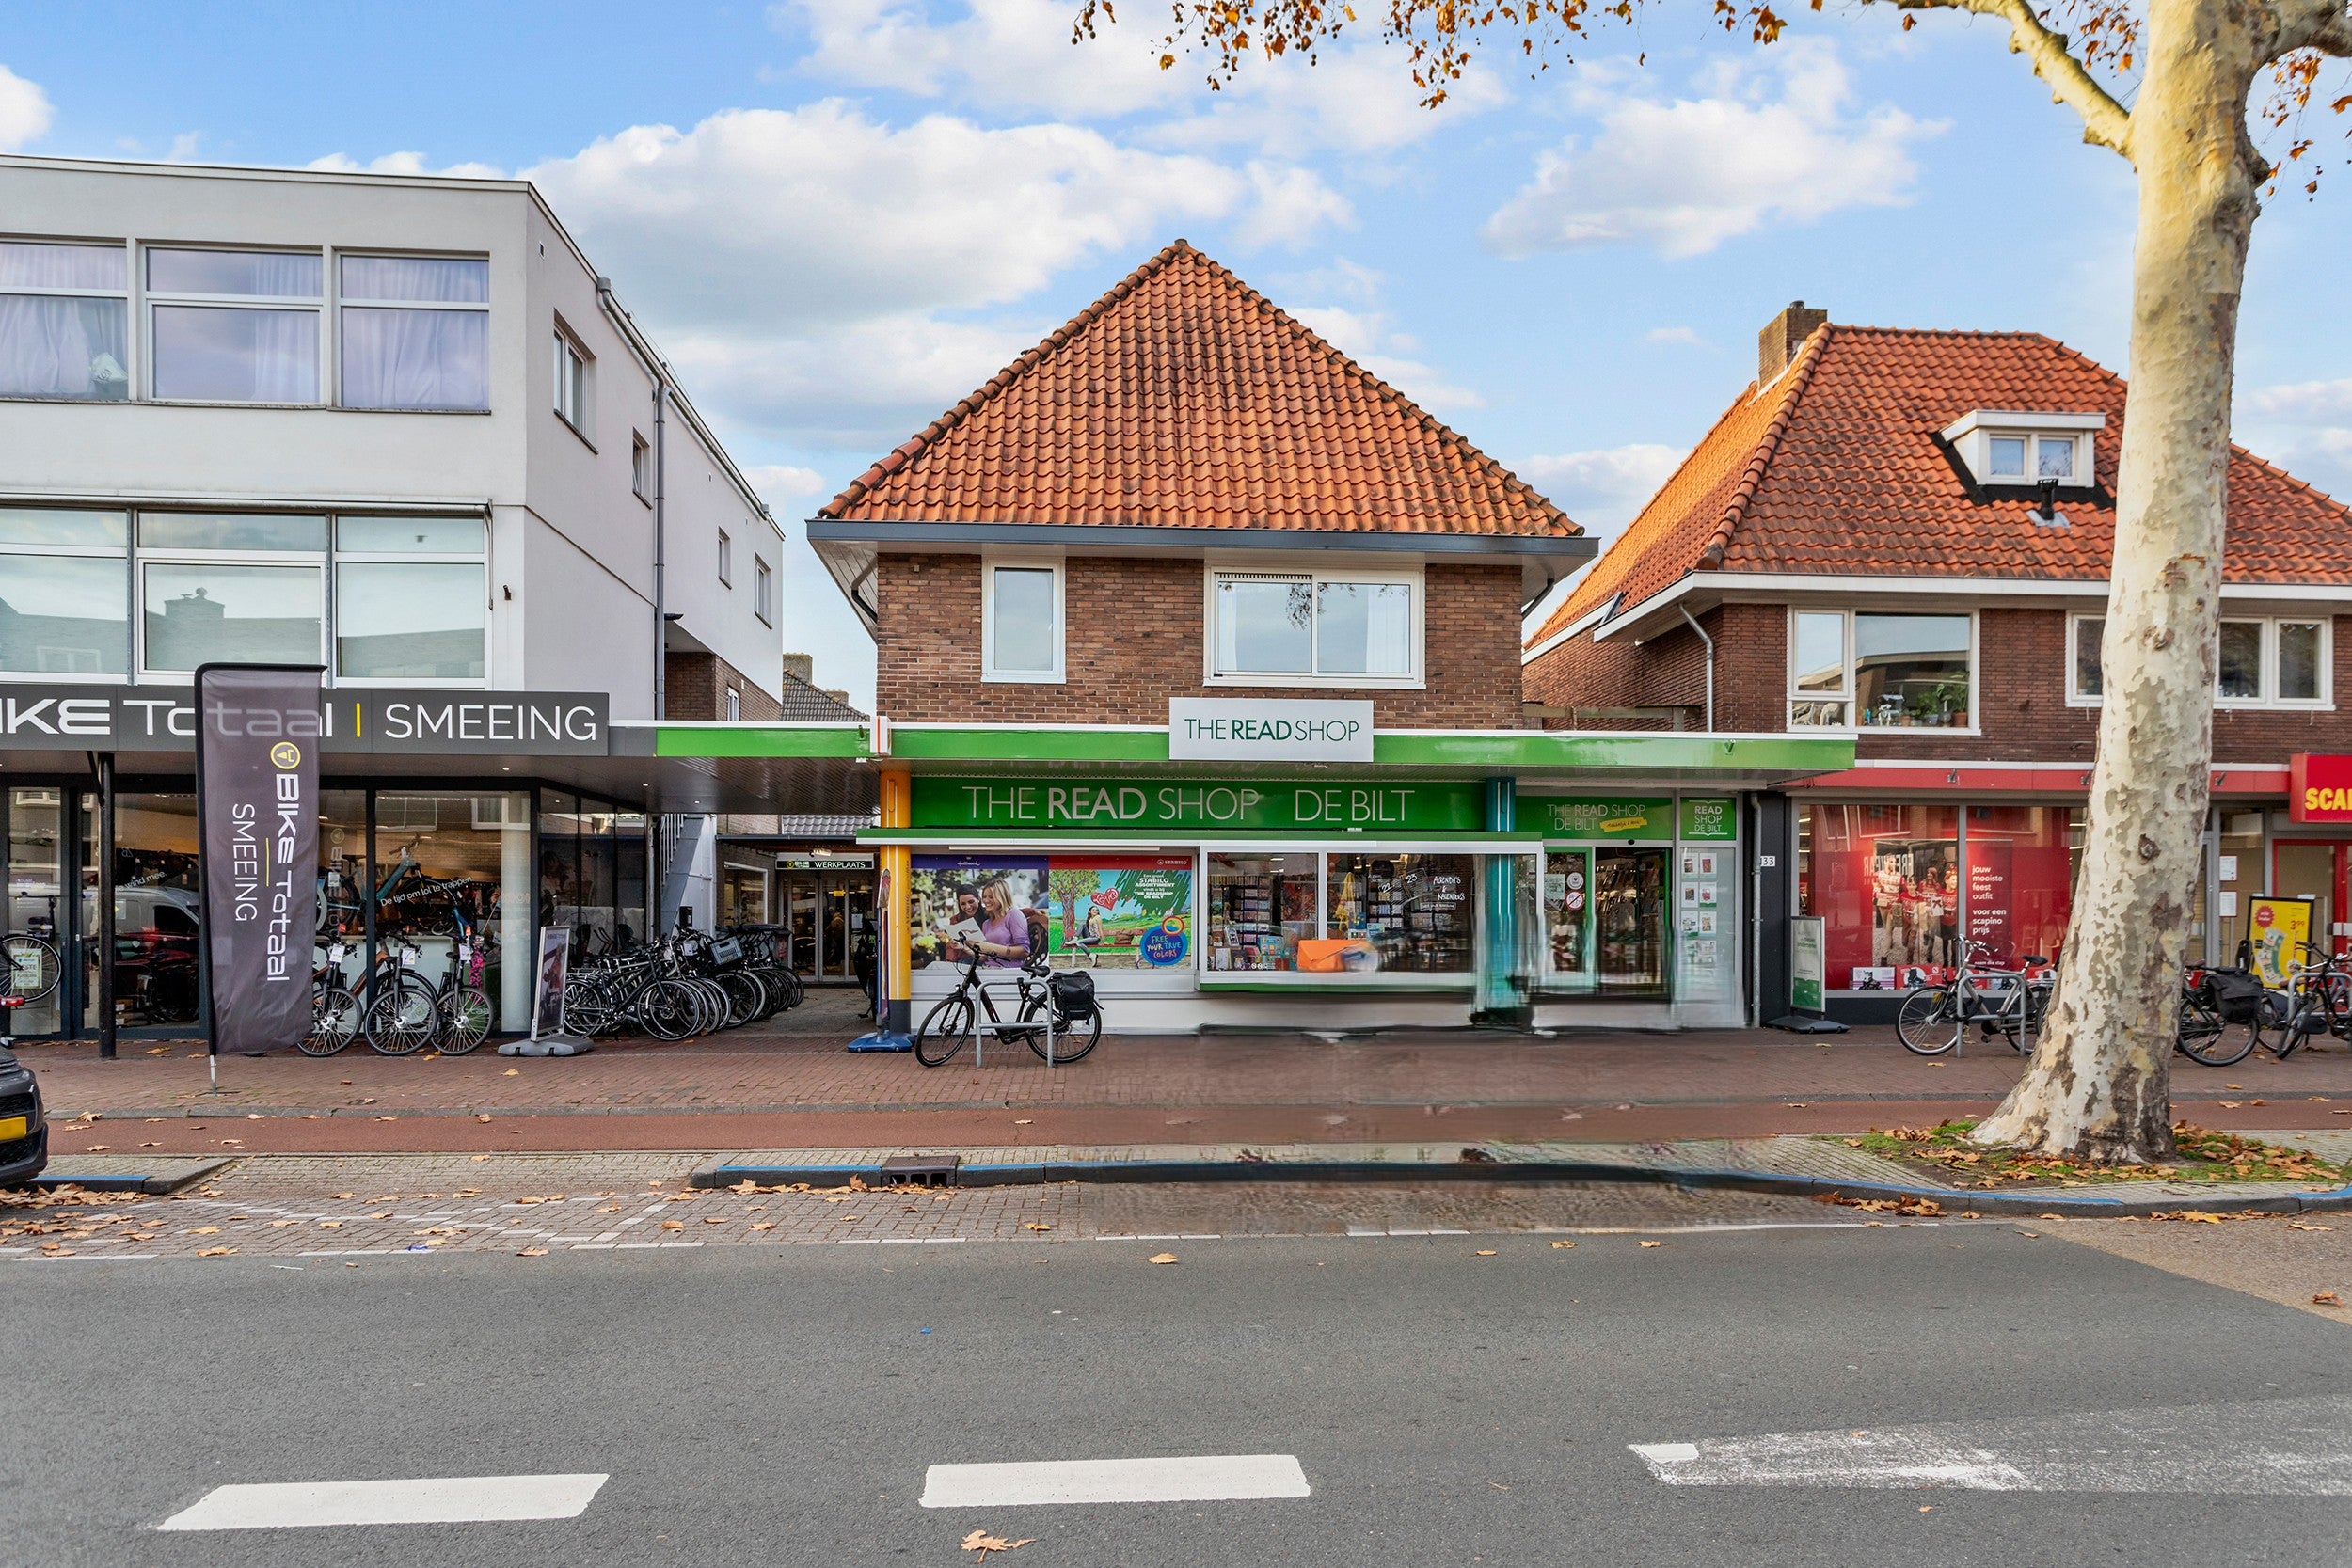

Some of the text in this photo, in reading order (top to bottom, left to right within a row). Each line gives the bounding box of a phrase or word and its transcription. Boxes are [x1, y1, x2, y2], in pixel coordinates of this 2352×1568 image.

[385, 704, 596, 741] SMEEING
[1184, 718, 1359, 742] THE READ SHOP
[962, 786, 1416, 822] THE READ SHOP DE BILT
[1547, 804, 1646, 816] THE READ SHOP
[1694, 806, 1723, 815] READ
[1554, 817, 1570, 831] DE
[1574, 817, 1597, 831] BILT
[1694, 815, 1723, 824] SHOP
[232, 803, 258, 922] SMEEING
[1972, 864, 1991, 874] jouw
[267, 773, 300, 981] BIKE Totaal
[1972, 874, 2003, 882] mooiste
[380, 898, 392, 907] De
[393, 894, 406, 904] tijd
[407, 890, 421, 900] om
[433, 884, 440, 893] te
[441, 876, 472, 890] trappen
[1972, 892, 1993, 900] outfit
[1972, 916, 2002, 927] scapino
[1972, 926, 1990, 935] prijs
[1151, 935, 1168, 943] FREE
[1147, 943, 1163, 952] YOUR
[1153, 949, 1177, 959] COLORS
